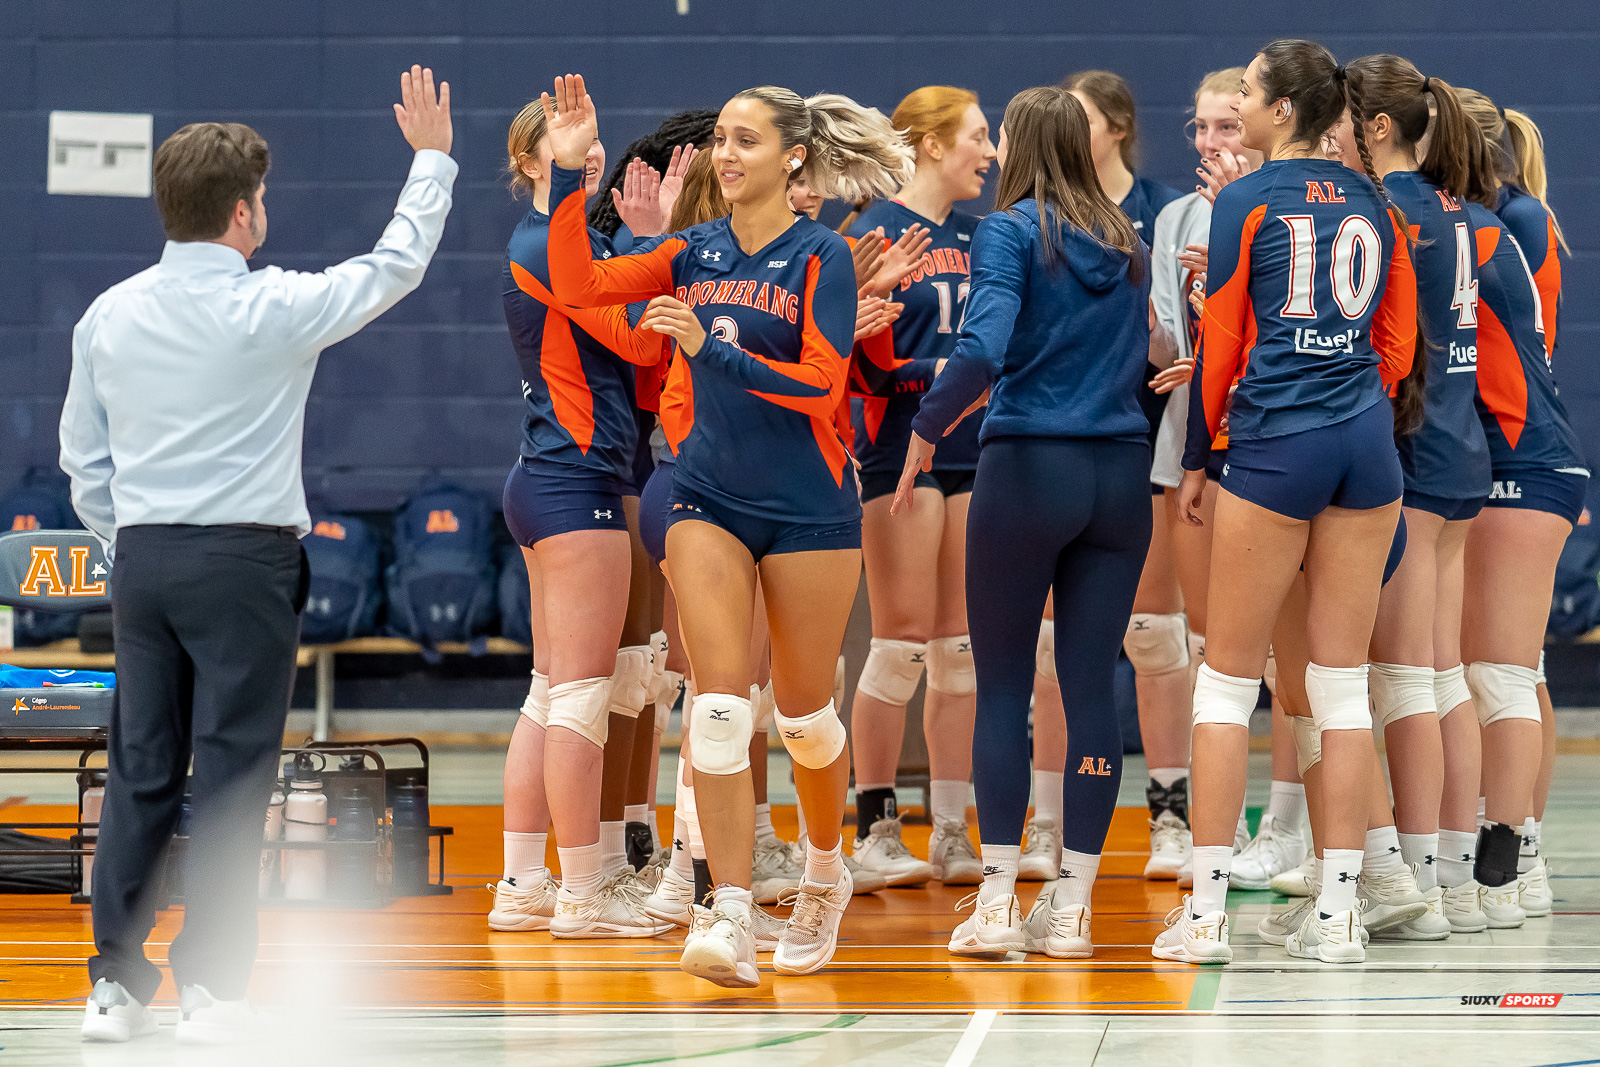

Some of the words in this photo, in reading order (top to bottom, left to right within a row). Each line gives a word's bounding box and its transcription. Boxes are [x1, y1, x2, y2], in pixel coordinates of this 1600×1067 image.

[1305, 181, 1346, 203] AL
[1276, 214, 1382, 320] 10
[1450, 222, 1478, 329] 4
[676, 280, 798, 324] BOOMERANG
[711, 316, 741, 349] 3
[1489, 481, 1521, 499] AL
[20, 546, 106, 596] AL
[1078, 757, 1111, 776] AL
